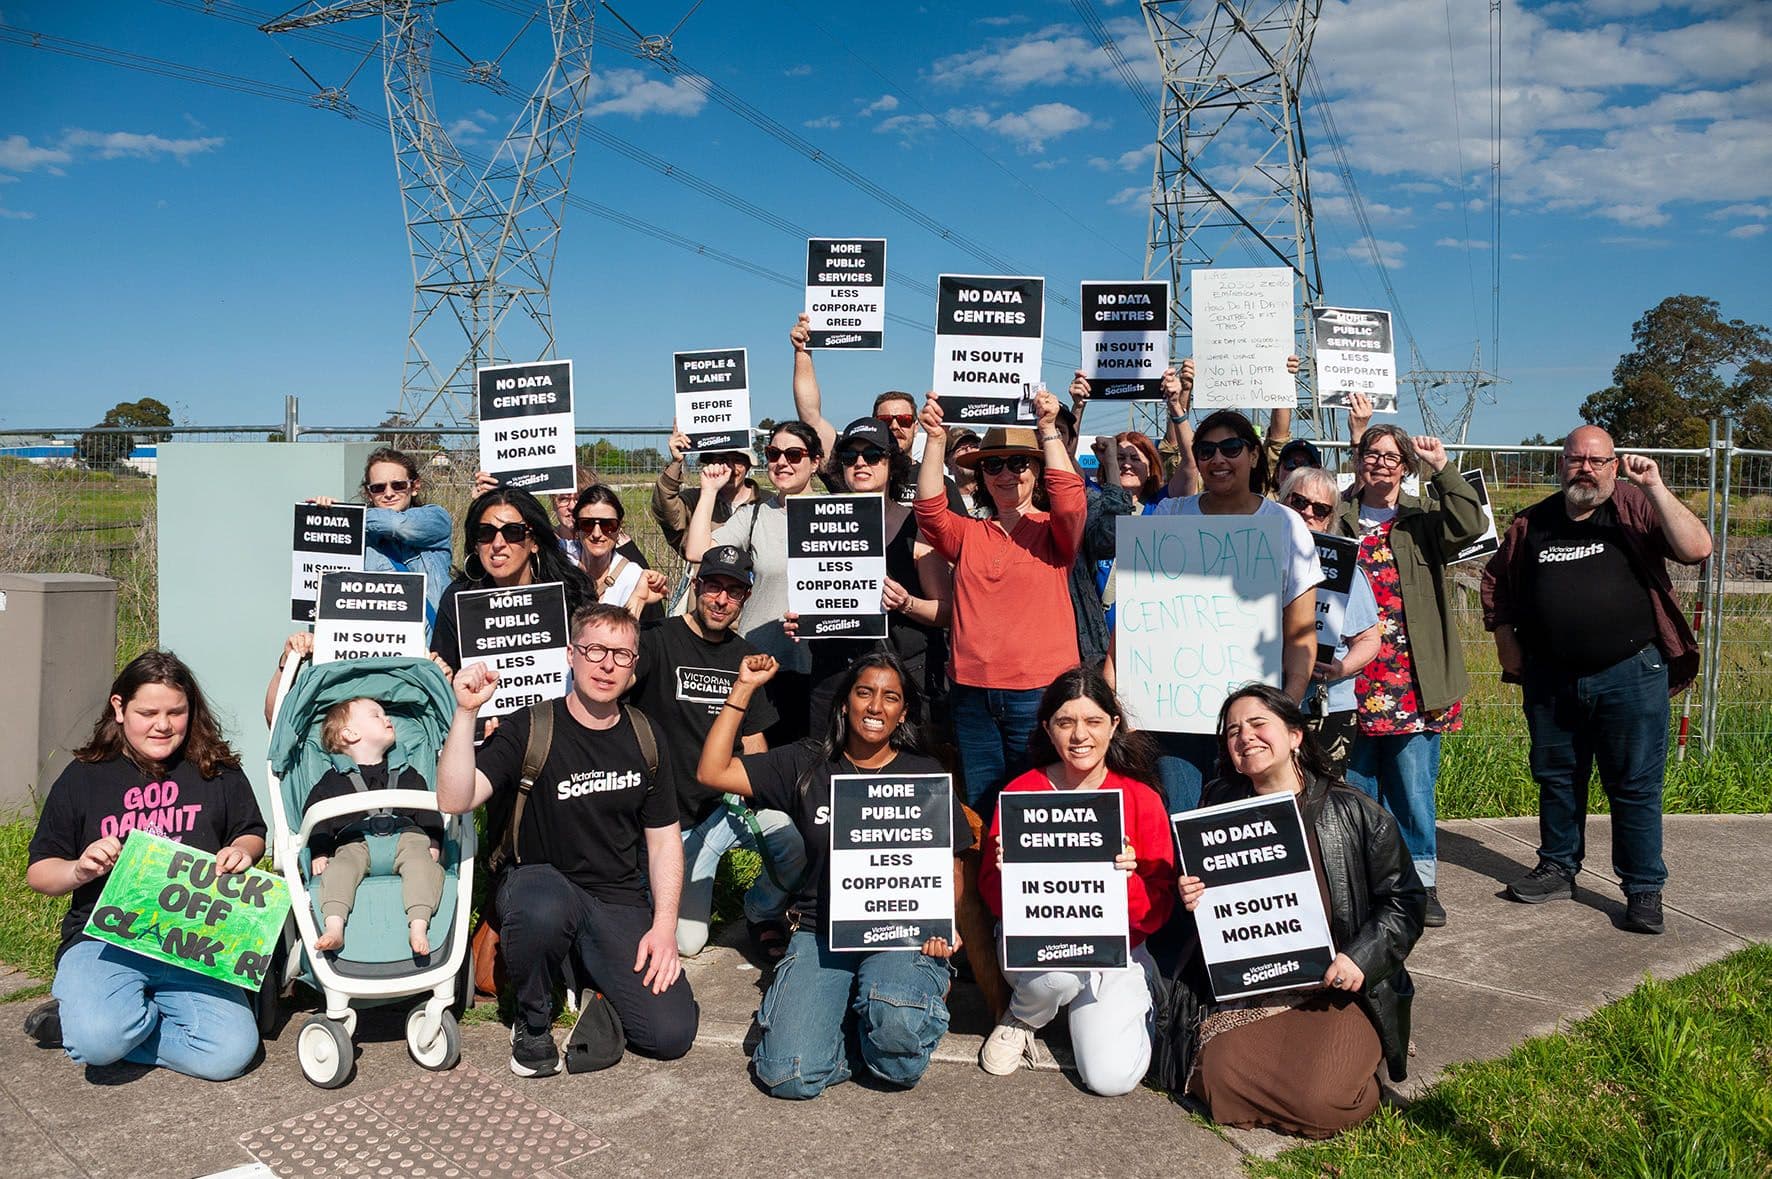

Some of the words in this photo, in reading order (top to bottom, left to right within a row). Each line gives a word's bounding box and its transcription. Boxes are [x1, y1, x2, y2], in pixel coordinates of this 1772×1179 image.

[830, 244, 862, 254] MORE
[826, 258, 866, 268] PUBLIC
[818, 273, 872, 282] SERVICES
[830, 289, 859, 298] LESS
[958, 289, 980, 302] NO
[983, 290, 1022, 304] DATA
[1098, 294, 1116, 305] NO
[1118, 294, 1151, 305] DATA
[812, 304, 877, 312] CORPORATE
[1244, 300, 1255, 310] AI
[826, 318, 862, 327] GREED
[953, 310, 1026, 324] CENTRES
[1094, 311, 1154, 321] CENTRES
[1333, 325, 1373, 336] PUBLIC
[1095, 342, 1108, 352] IN
[1111, 342, 1154, 352] SOUTH
[1326, 338, 1381, 349] SERVICES
[951, 350, 967, 361] IN
[970, 350, 1024, 364] SOUTH
[1097, 358, 1152, 368] MORANG
[1341, 353, 1369, 362] LESS
[684, 359, 725, 371] PEOPLE
[726, 358, 736, 368] &
[1204, 364, 1225, 377] NO
[1230, 364, 1244, 377] AI
[1249, 364, 1275, 377] DATA
[1324, 365, 1389, 377] CORPORATE
[496, 378, 515, 390] NO
[517, 376, 552, 388] DATA
[689, 373, 732, 384] PLANET
[953, 371, 1020, 384] MORANG
[1105, 383, 1145, 396] Socialists
[493, 392, 557, 408] CENTRES
[691, 399, 733, 410] BEFORE
[960, 404, 1010, 418] Socialists
[693, 413, 732, 424] PROFIT
[495, 432, 507, 442] IN
[511, 426, 557, 440] SOUTH
[497, 445, 556, 460] MORANG
[814, 503, 853, 515] MORE
[306, 515, 322, 526] NO
[323, 516, 350, 528] DATA
[809, 521, 859, 534] PUBLIC
[303, 531, 352, 544] CENTRES
[801, 540, 869, 552] SERVICES
[1539, 543, 1604, 563] Socialists
[1134, 530, 1187, 588] NO
[1198, 527, 1278, 583] DATA
[303, 563, 313, 573] IN
[818, 561, 853, 572] LESS
[341, 582, 363, 593] NO
[365, 582, 404, 595] DATA
[796, 579, 877, 591] CORPORATE
[335, 598, 408, 611] CENTRES
[489, 594, 533, 609] MORE
[815, 598, 859, 609] GREED
[1122, 594, 1258, 633] CENTRES
[485, 612, 540, 630] PUBLIC
[815, 619, 860, 634] Socialists
[334, 632, 348, 642] IN
[353, 633, 406, 644] SOUTH
[476, 631, 552, 650] SERVICES
[496, 656, 535, 669] LESS
[1130, 646, 1152, 676] IN
[1174, 643, 1263, 679] OUR
[496, 671, 562, 689] RPORATE
[684, 672, 730, 686] VICTORIAN
[683, 680, 733, 694] SOCIALIST
[495, 694, 543, 709] GREED
[570, 769, 605, 783] Victorian
[557, 769, 641, 800] Socialists
[868, 784, 915, 799] MORE
[124, 781, 179, 810] GOD
[861, 806, 922, 821] PUBLIC
[1023, 808, 1048, 823] NO
[1051, 808, 1098, 823] DATA
[101, 804, 202, 839] DAMNIT
[850, 828, 934, 843] SERVICES
[1020, 832, 1104, 847] CENTRES
[1201, 829, 1228, 847] NO
[1228, 820, 1277, 842] DATA
[870, 854, 913, 867] LESS
[1202, 844, 1288, 872] CENTRES
[166, 850, 273, 908] FUCK
[841, 876, 942, 890] CORPORATE
[1022, 880, 1039, 894] IN
[1043, 880, 1105, 894] SOUTH
[158, 883, 232, 926] OFF
[864, 899, 919, 913] GREED
[1213, 903, 1233, 919] IN
[1234, 892, 1298, 916] SOUTH
[1025, 905, 1104, 919] MORANG
[863, 925, 920, 944] Socialists
[872, 925, 895, 933] Victorian
[1221, 918, 1302, 944] MORANG
[1037, 943, 1095, 962] Socialists
[1045, 943, 1069, 951] Victorian
[1242, 960, 1300, 986] Socialists
[1249, 962, 1273, 974] Victorian
